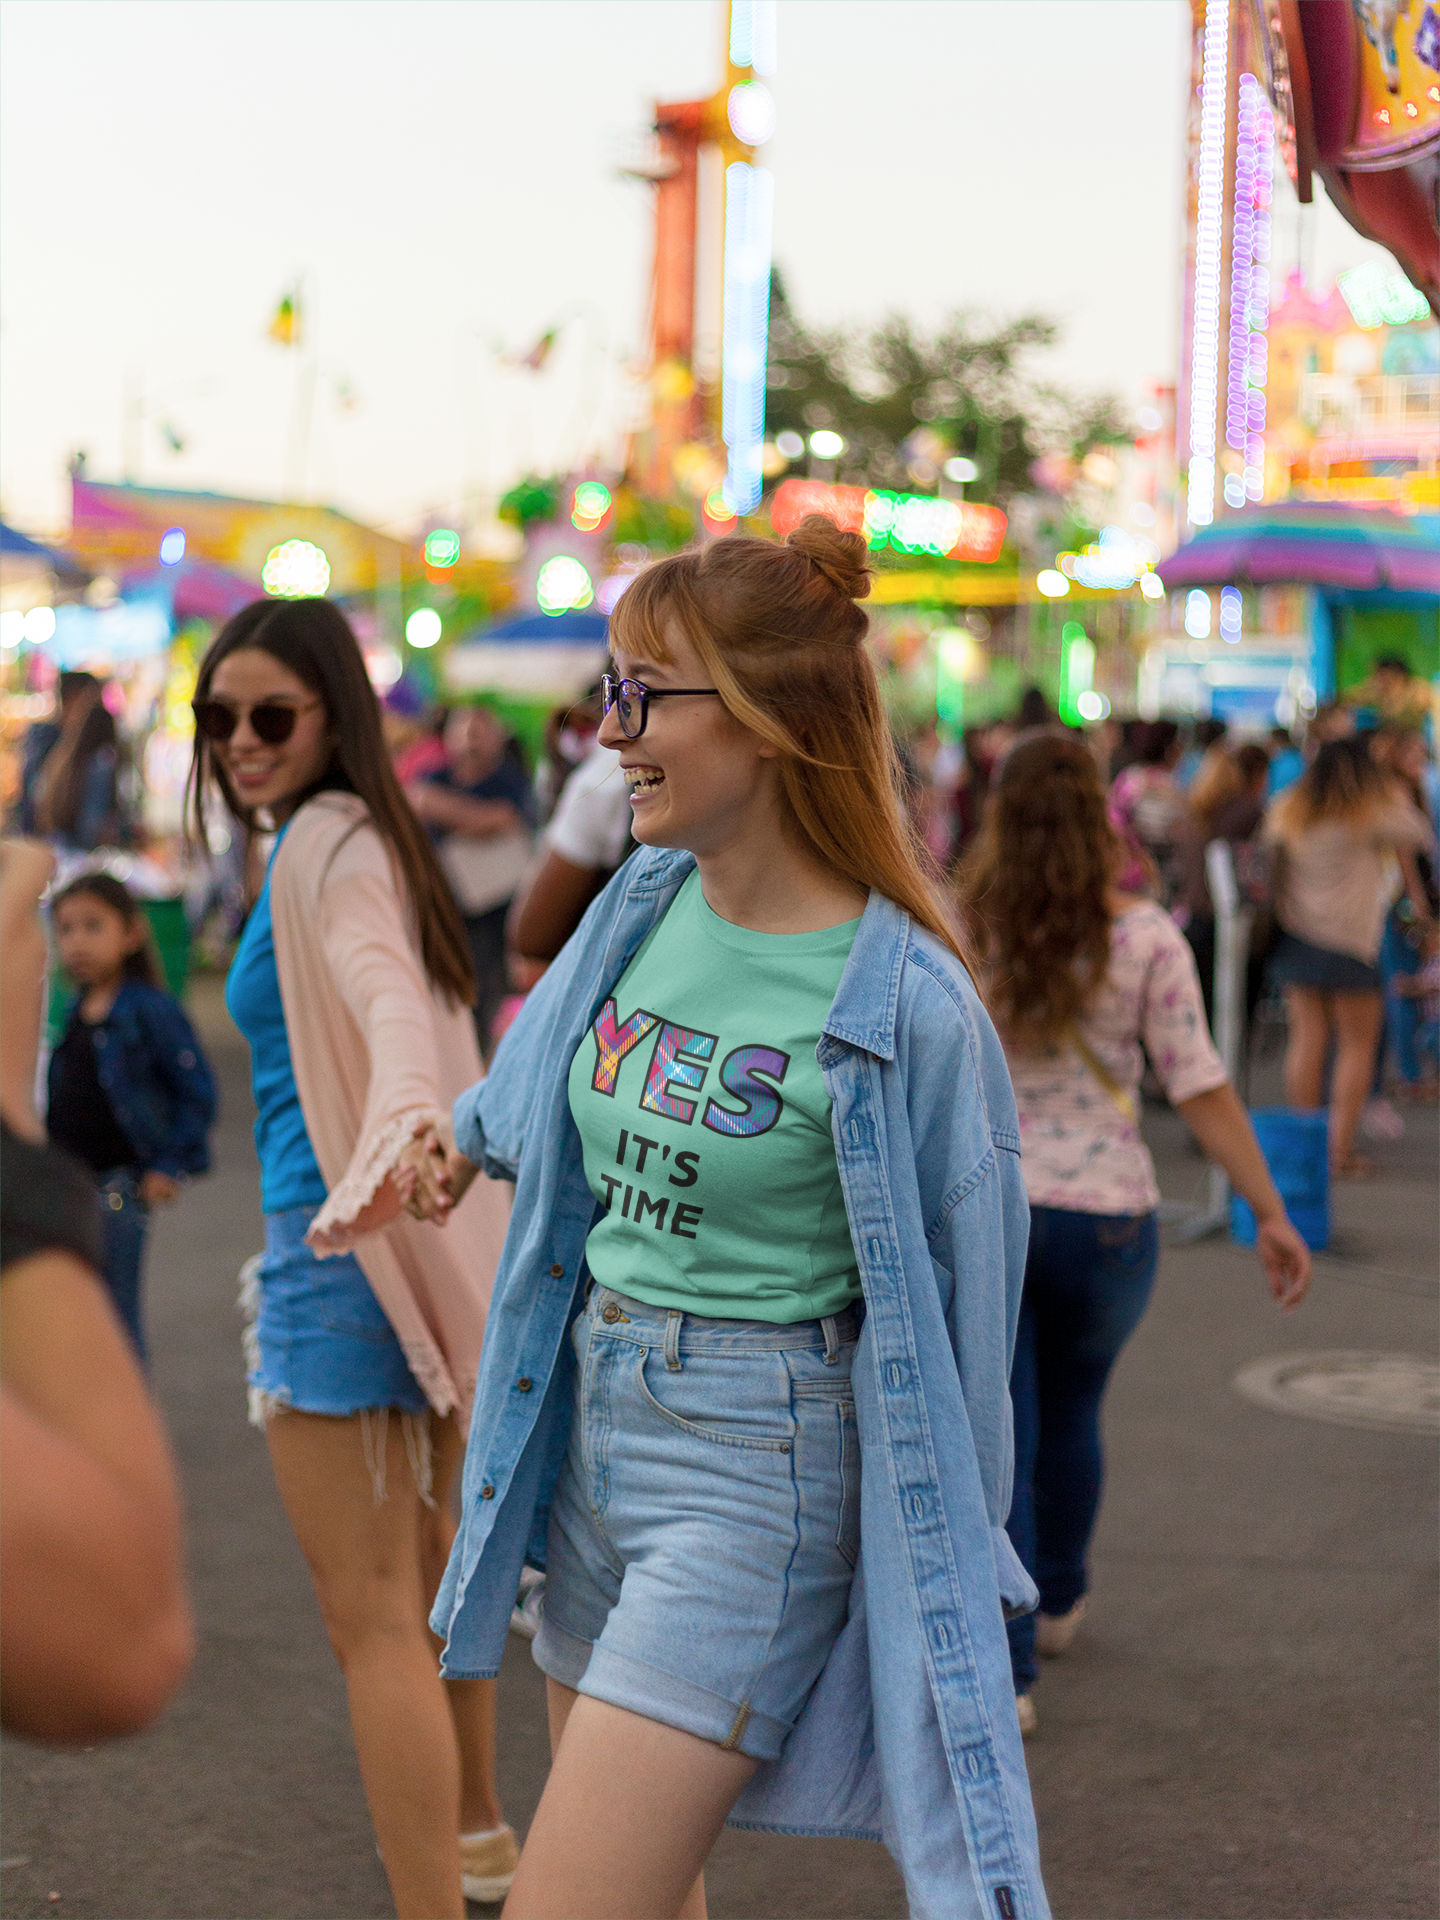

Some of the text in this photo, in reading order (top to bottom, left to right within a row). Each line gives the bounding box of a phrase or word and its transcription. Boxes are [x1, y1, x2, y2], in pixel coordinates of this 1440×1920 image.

[591, 995, 791, 1138] YES
[616, 1129, 700, 1187] IT'S
[601, 1173, 704, 1239] TIME
